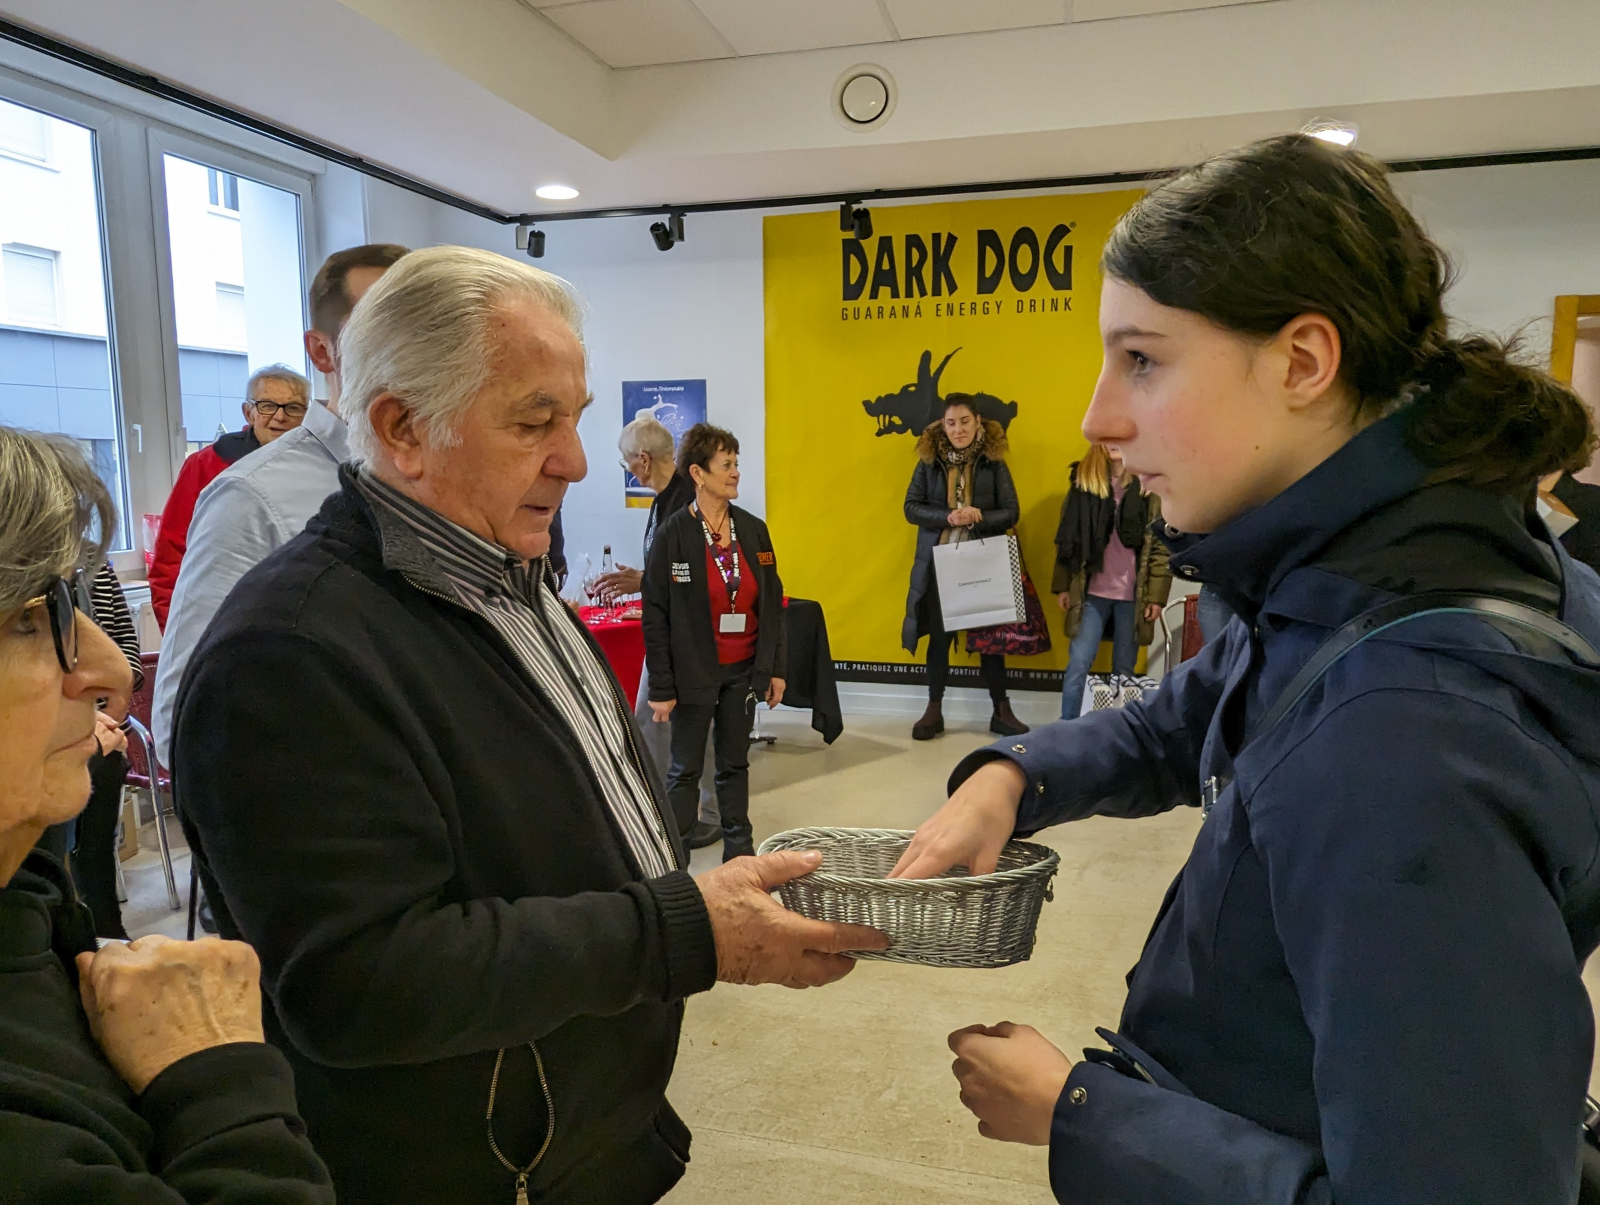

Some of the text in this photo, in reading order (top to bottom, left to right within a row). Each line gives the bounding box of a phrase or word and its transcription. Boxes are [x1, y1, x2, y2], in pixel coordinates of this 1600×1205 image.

[841, 231, 959, 301] DARK
[841, 297, 1073, 321] GUARANÁ ENERGY DRINK
[834, 662, 850, 671] NTÉ,
[852, 663, 891, 672] PRATIQUEZ
[894, 665, 908, 673] UNE
[910, 666, 927, 674] ACTI
[948, 667, 980, 677] PORTIVE
